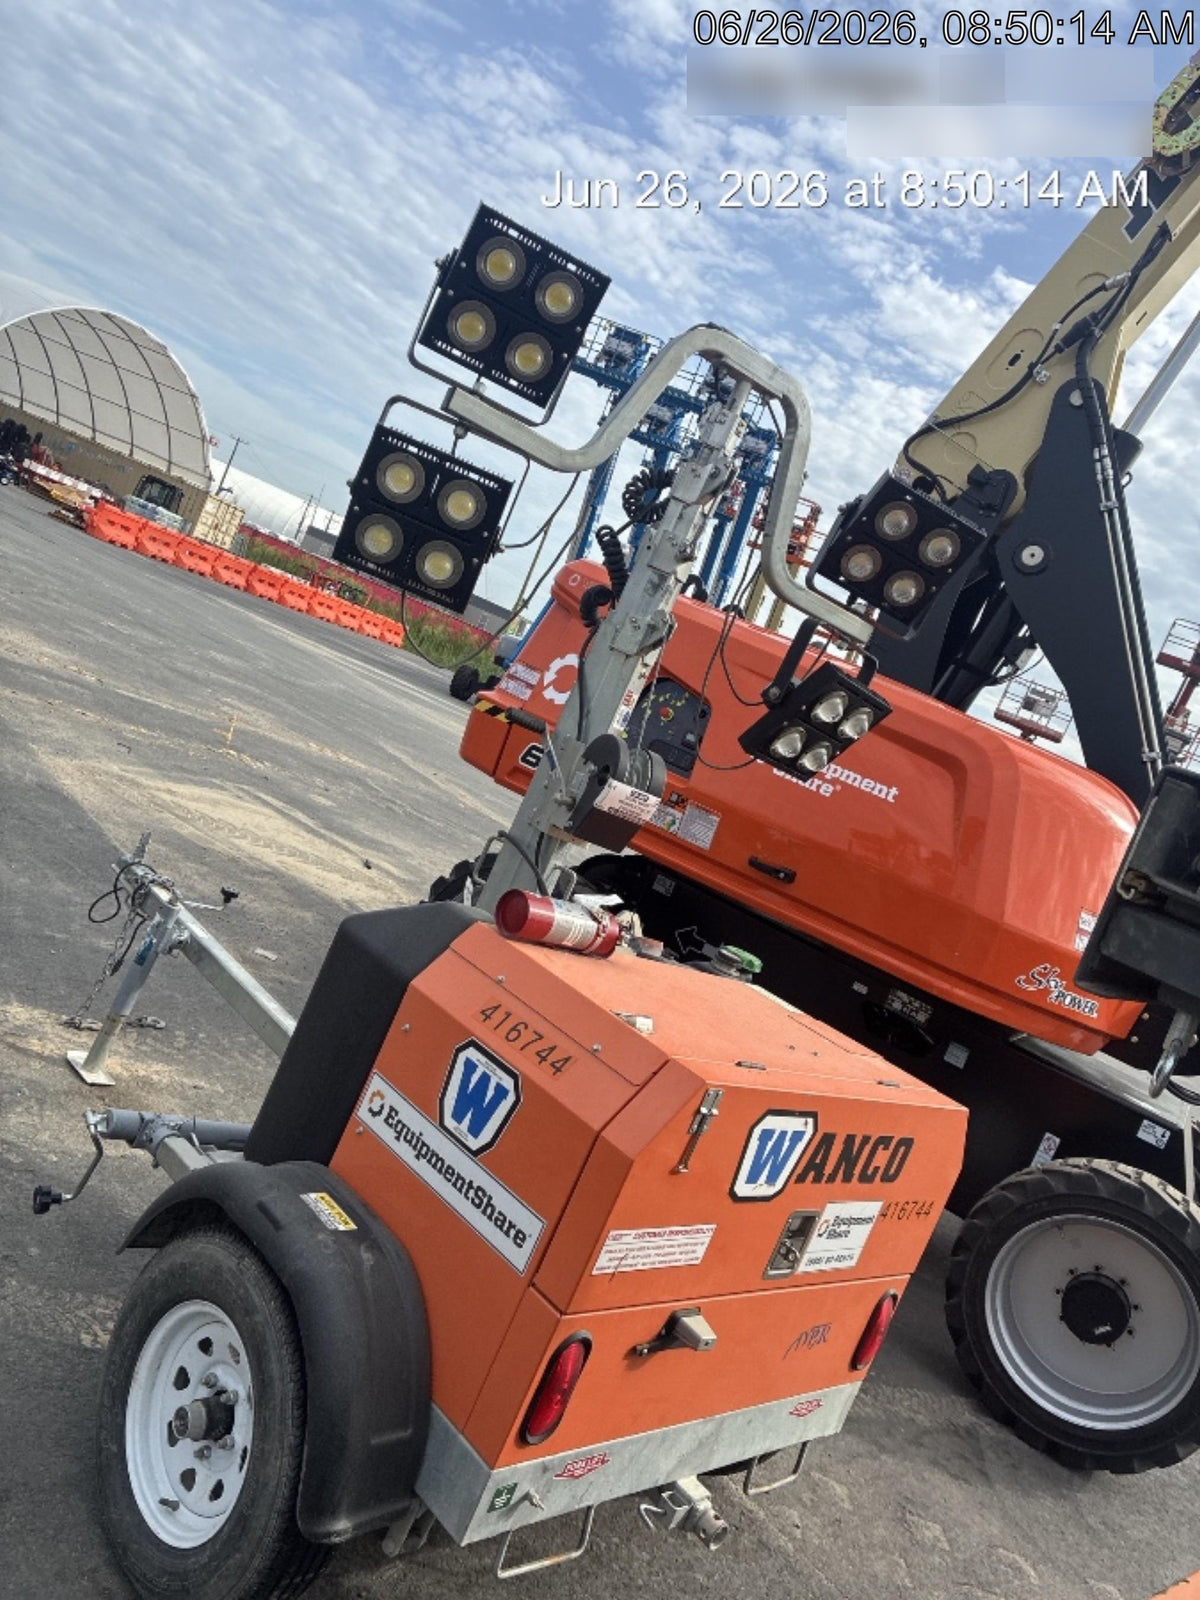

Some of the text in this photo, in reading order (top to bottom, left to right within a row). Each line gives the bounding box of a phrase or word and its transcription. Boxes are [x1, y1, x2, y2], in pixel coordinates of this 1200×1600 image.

[480, 1004, 574, 1077] 416744
[451, 1056, 510, 1139] W
[383, 1104, 528, 1249] EquipmentShare
[744, 1128, 915, 1185] WANCO
[880, 1200, 935, 1221] 416744
